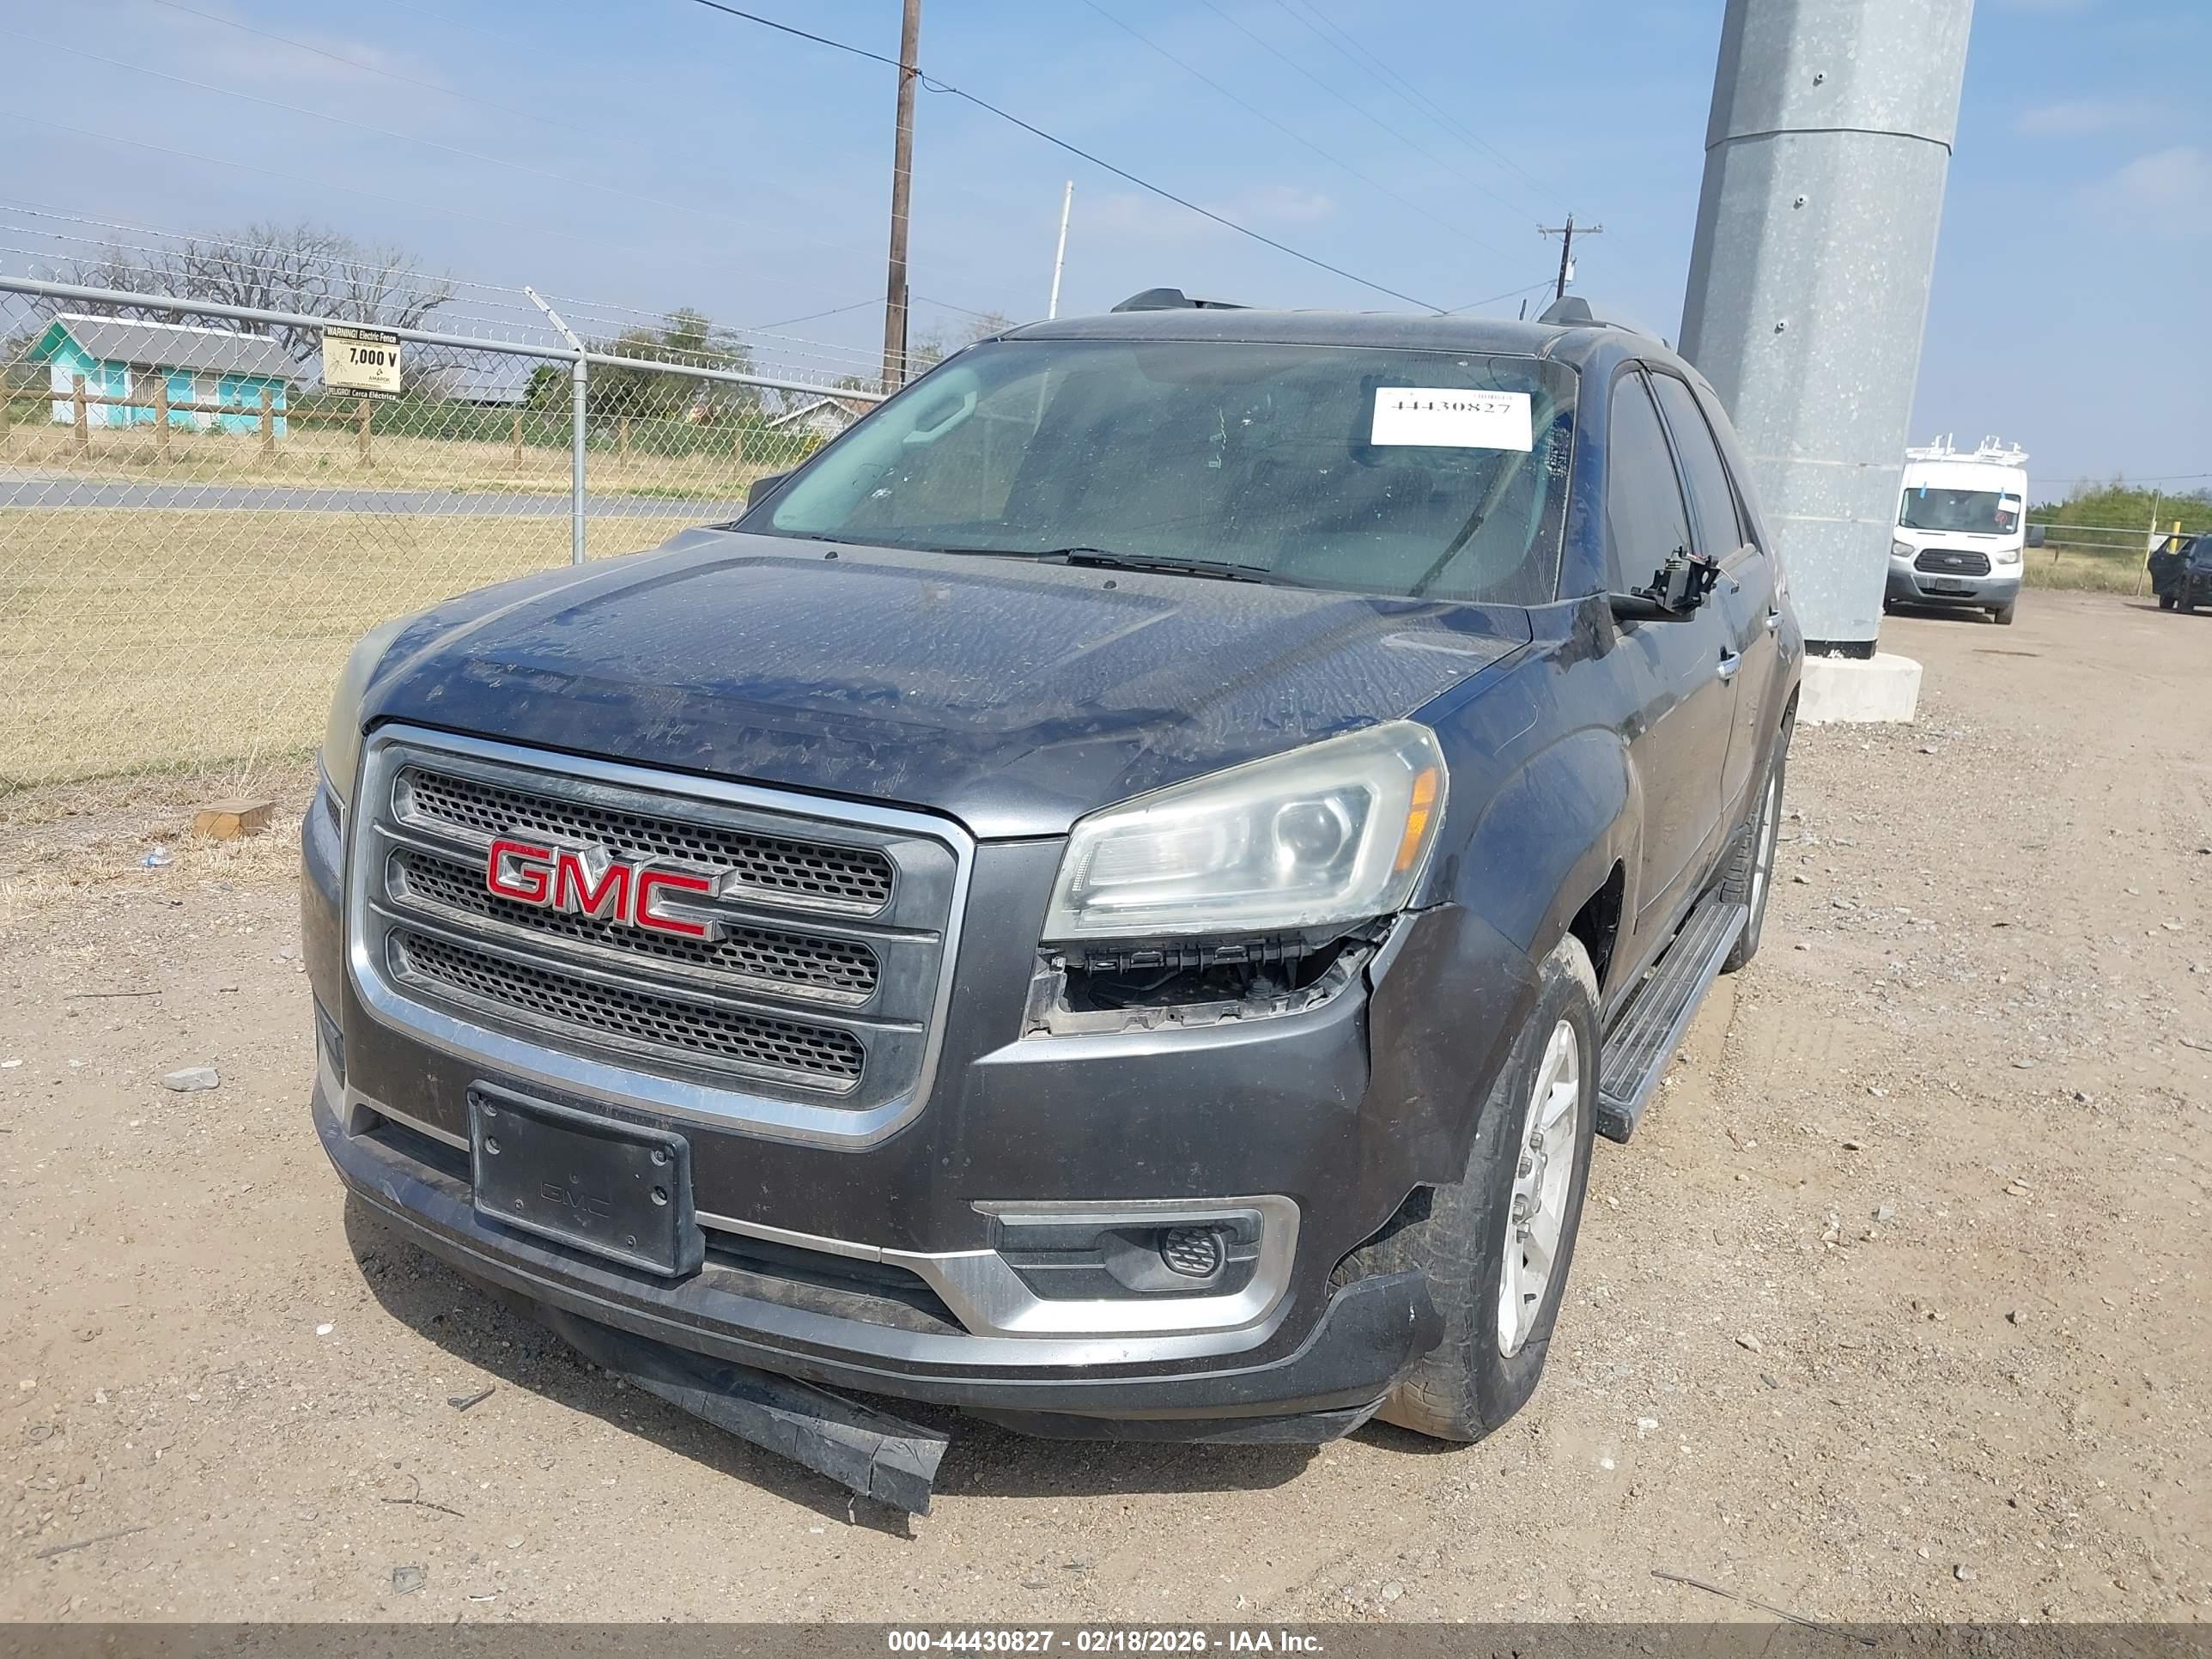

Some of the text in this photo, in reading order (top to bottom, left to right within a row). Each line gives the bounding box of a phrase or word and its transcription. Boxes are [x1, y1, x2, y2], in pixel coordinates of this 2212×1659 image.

[327, 326, 396, 343] WARNING! Electric Fence
[349, 348, 397, 367] 7,000 V
[352, 389, 368, 398] Cerca
[1391, 401, 1510, 413] 44430827
[486, 833, 721, 942] GMC
